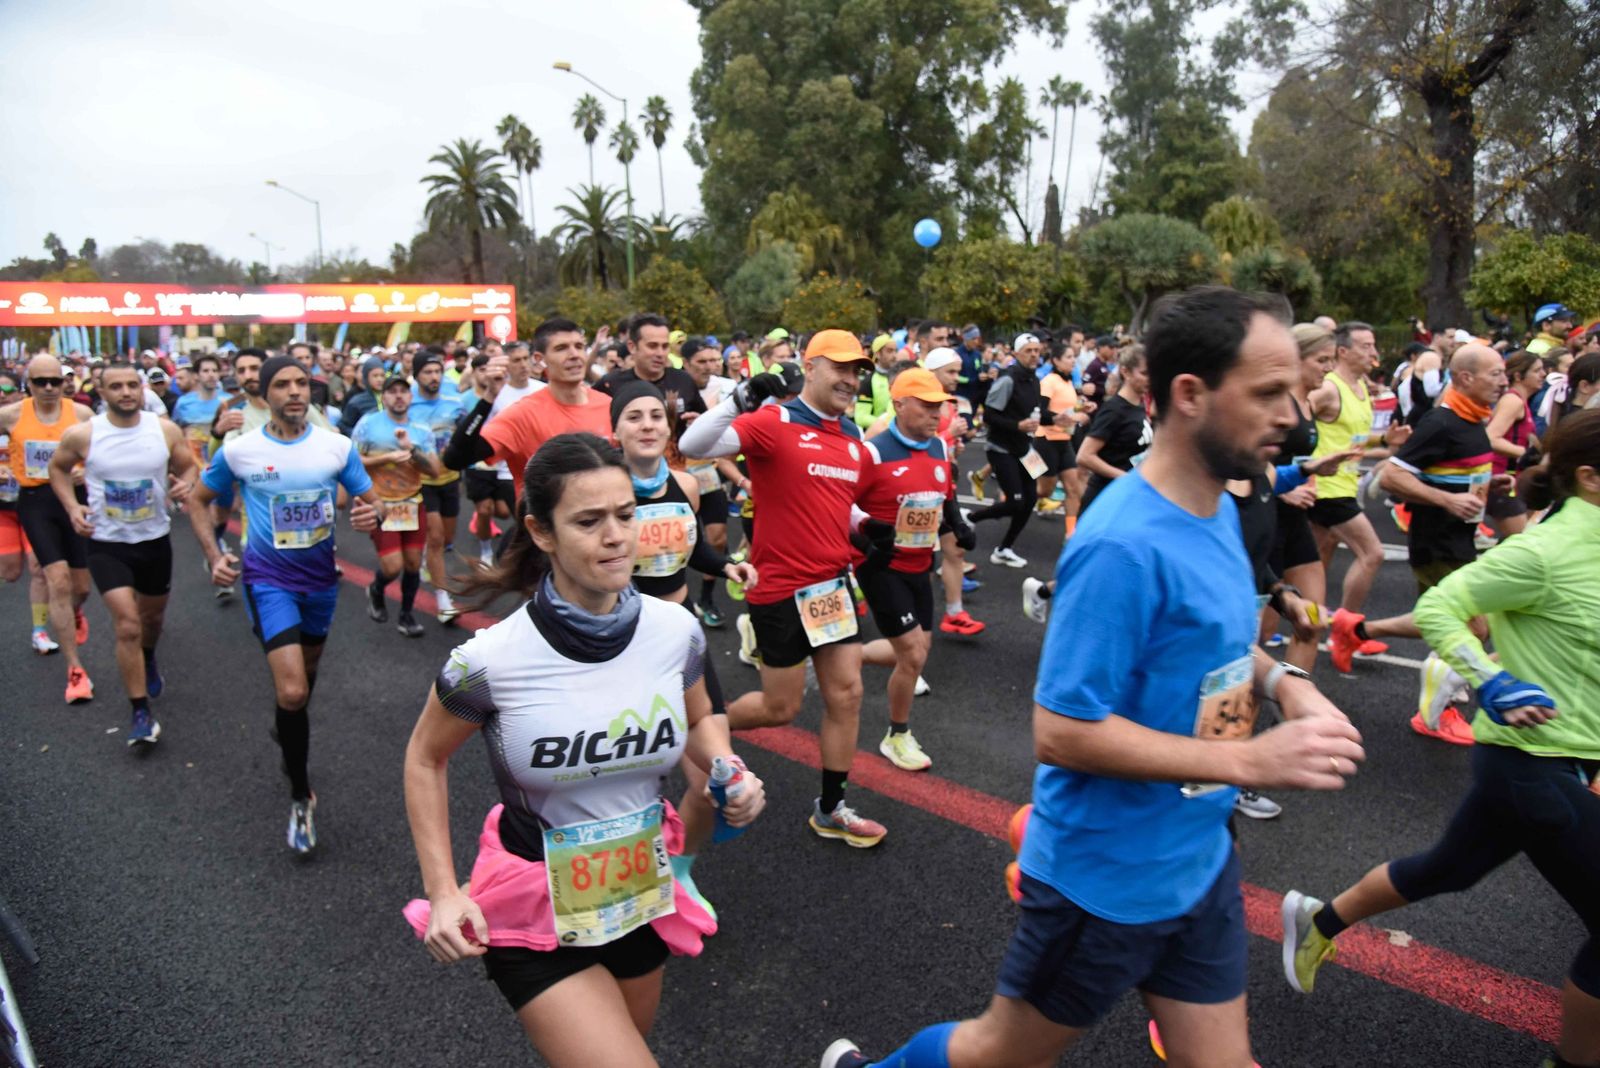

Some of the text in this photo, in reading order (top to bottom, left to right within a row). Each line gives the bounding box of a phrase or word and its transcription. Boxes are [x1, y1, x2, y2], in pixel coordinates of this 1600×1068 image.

[282, 503, 320, 523] 3578
[906, 510, 937, 526] 6297
[639, 521, 684, 545] 4973
[809, 595, 841, 618] 6296
[571, 840, 650, 891] 8736
